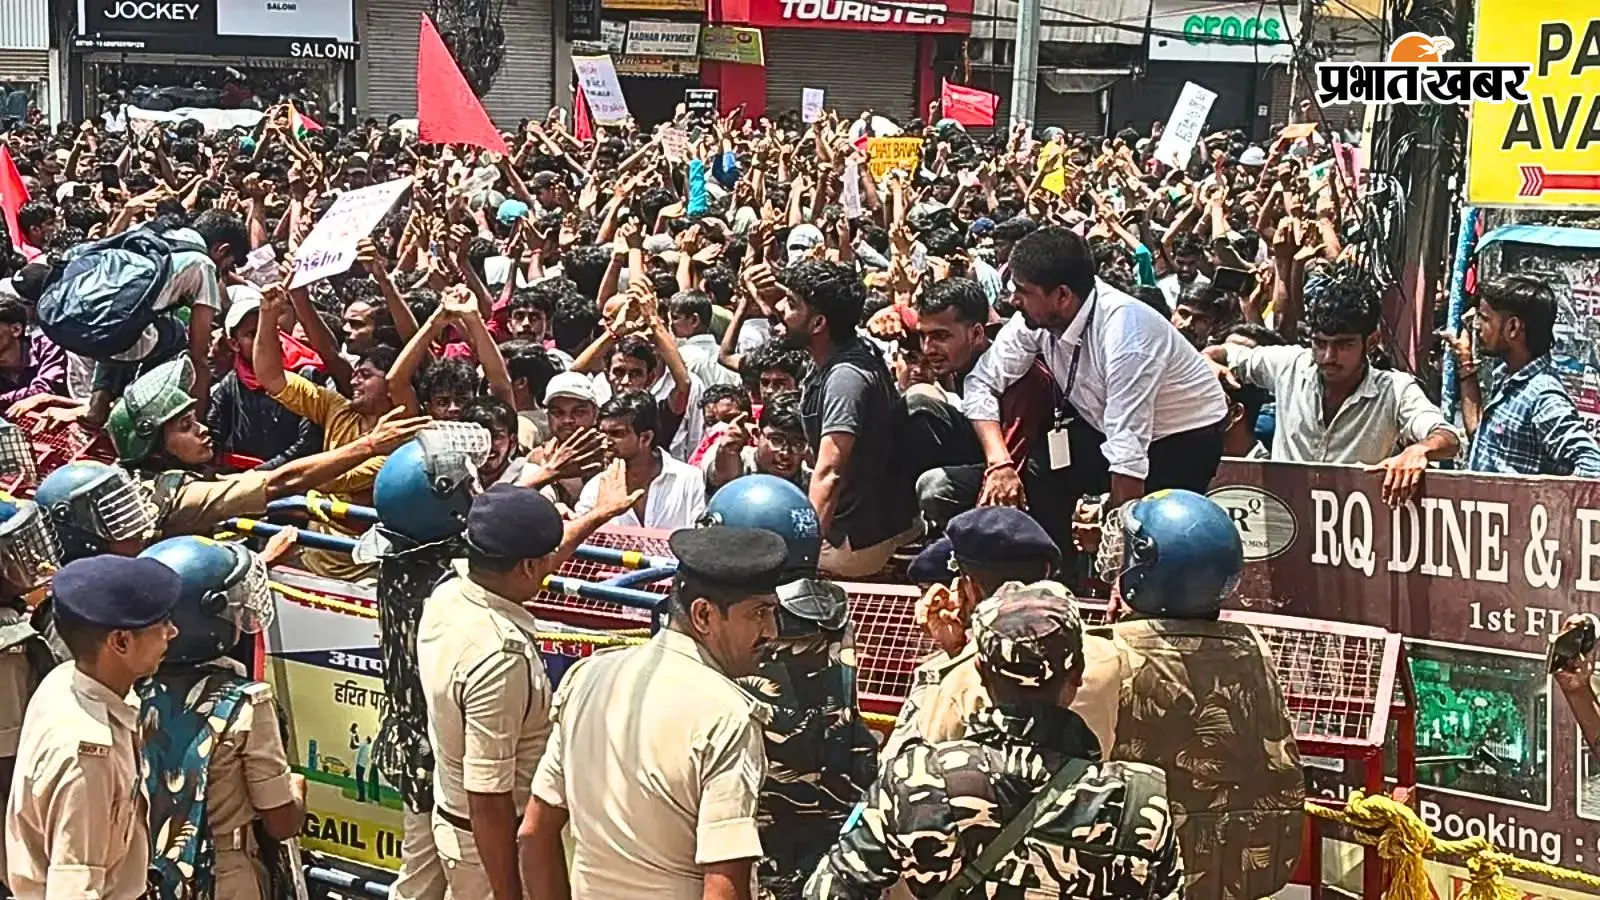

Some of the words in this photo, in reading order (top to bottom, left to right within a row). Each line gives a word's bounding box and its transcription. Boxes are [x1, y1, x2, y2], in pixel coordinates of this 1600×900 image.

[103, 1, 200, 20] JOCKEY
[266, 3, 297, 11] SALONI
[780, 0, 947, 25] TOURISTER
[660, 32, 696, 43] PAYMENT
[1184, 14, 1280, 46] crocs
[290, 42, 354, 60] SALONI
[1538, 20, 1600, 77] PA
[1501, 95, 1600, 151] AVA
[1311, 489, 1376, 577] RQ
[1388, 498, 1509, 583] DINE
[1524, 504, 1562, 589] &
[1469, 602, 1516, 633] 1st
[334, 679, 368, 707] हरित
[303, 812, 366, 850] GAIL
[1419, 800, 1561, 865] Booking
